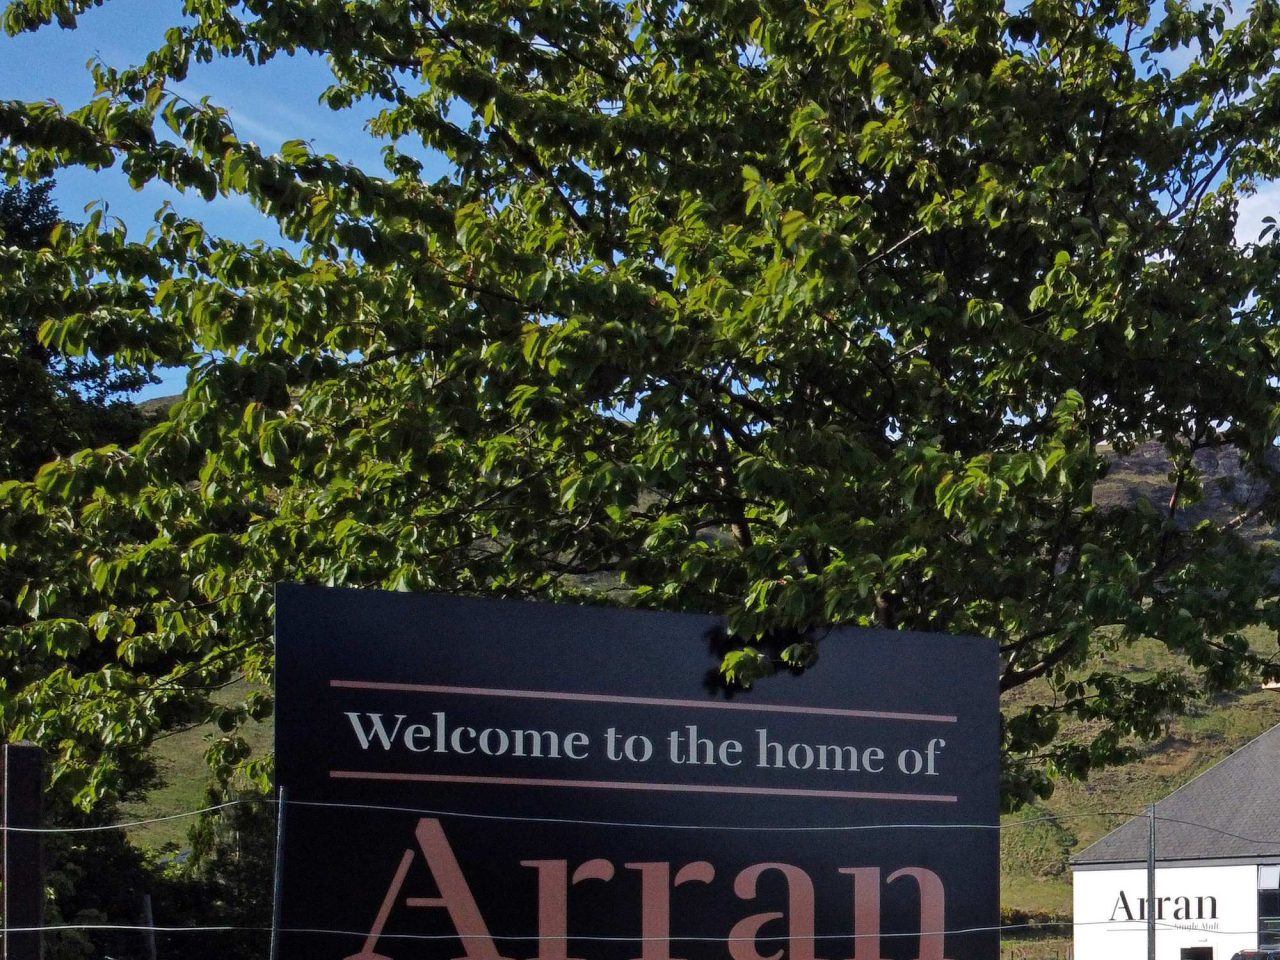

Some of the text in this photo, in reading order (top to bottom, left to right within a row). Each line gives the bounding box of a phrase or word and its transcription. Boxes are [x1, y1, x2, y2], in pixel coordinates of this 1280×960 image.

[344, 711, 946, 776] Welcome to the home of
[1108, 890, 1219, 920] Arran
[1201, 922, 1219, 930] Malt
